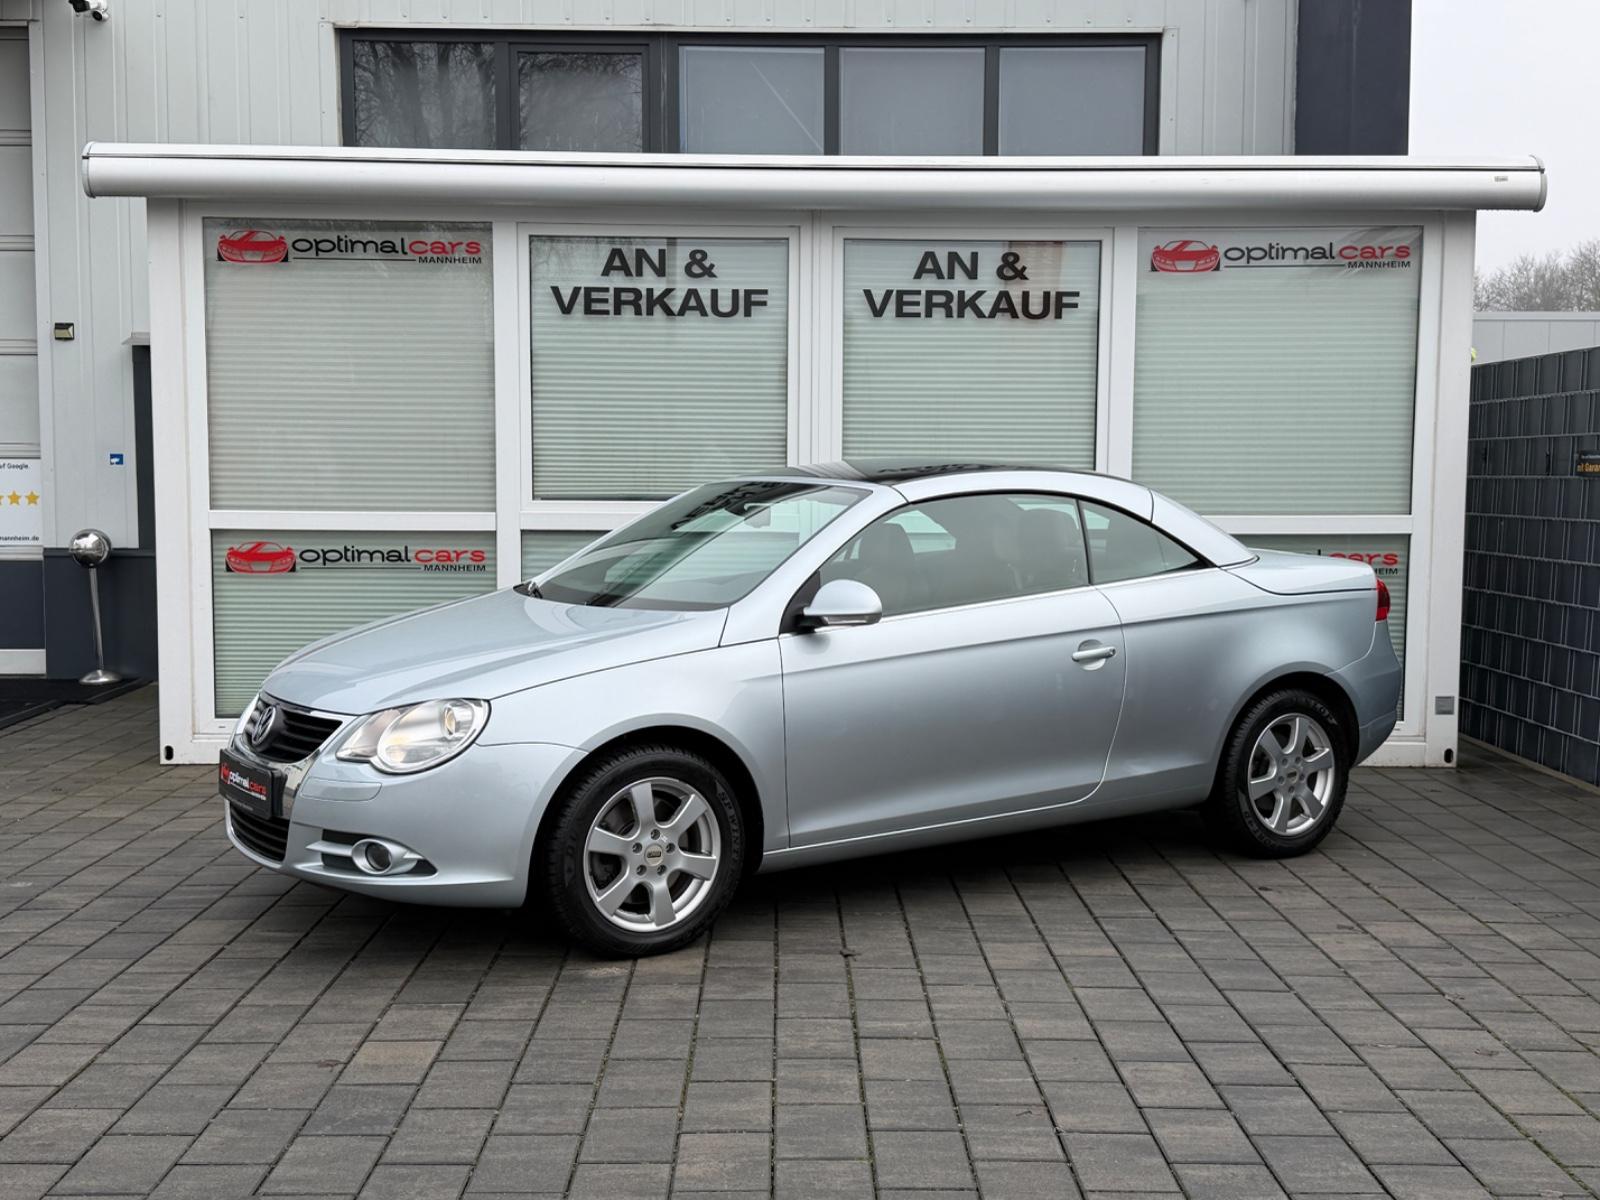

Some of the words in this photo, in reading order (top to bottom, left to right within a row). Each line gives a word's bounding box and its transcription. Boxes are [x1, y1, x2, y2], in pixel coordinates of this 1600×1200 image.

[418, 256, 482, 264] MANNHEIM
[601, 247, 666, 278] AN
[684, 249, 718, 279] &
[913, 251, 979, 280] AN
[996, 251, 1029, 281] &
[1347, 261, 1411, 269] MANNHEIM
[550, 286, 769, 318] VERKAUF
[862, 289, 1080, 320] VERKAUF
[423, 564, 486, 572] MANNHEIM
